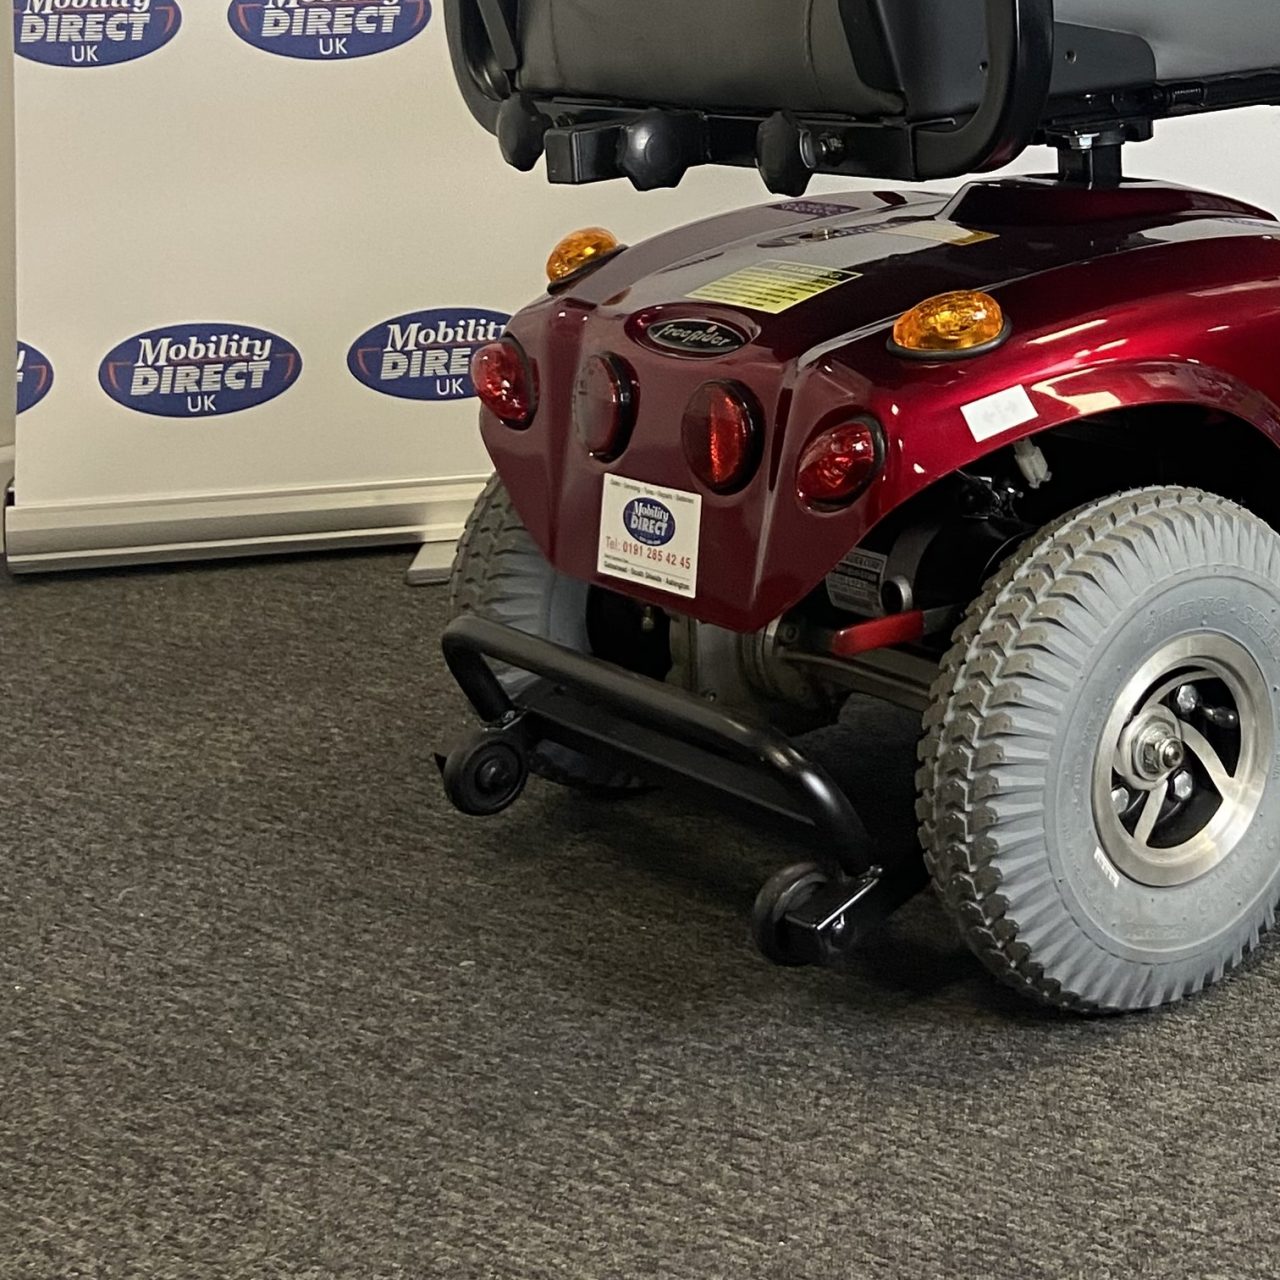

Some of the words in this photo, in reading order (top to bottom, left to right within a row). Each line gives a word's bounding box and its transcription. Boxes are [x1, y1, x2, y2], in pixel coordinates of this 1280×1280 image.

[20, 13, 151, 43] DIRECT
[261, 6, 401, 37] DIRECT
[71, 45, 99, 63] UK
[318, 37, 348, 55] UK
[382, 318, 506, 352] Mobilit
[136, 335, 273, 368] Mobility
[380, 347, 472, 380] DIRE
[130, 360, 272, 395] DIRECT
[435, 377, 464, 396] UK
[187, 394, 217, 413] UK
[630, 515, 668, 536] DIRECT
[634, 500, 670, 522] Mobility
[622, 540, 643, 557] 0191
[647, 547, 663, 563] 285
[666, 552, 677, 566] 42
[680, 557, 691, 570] 45
